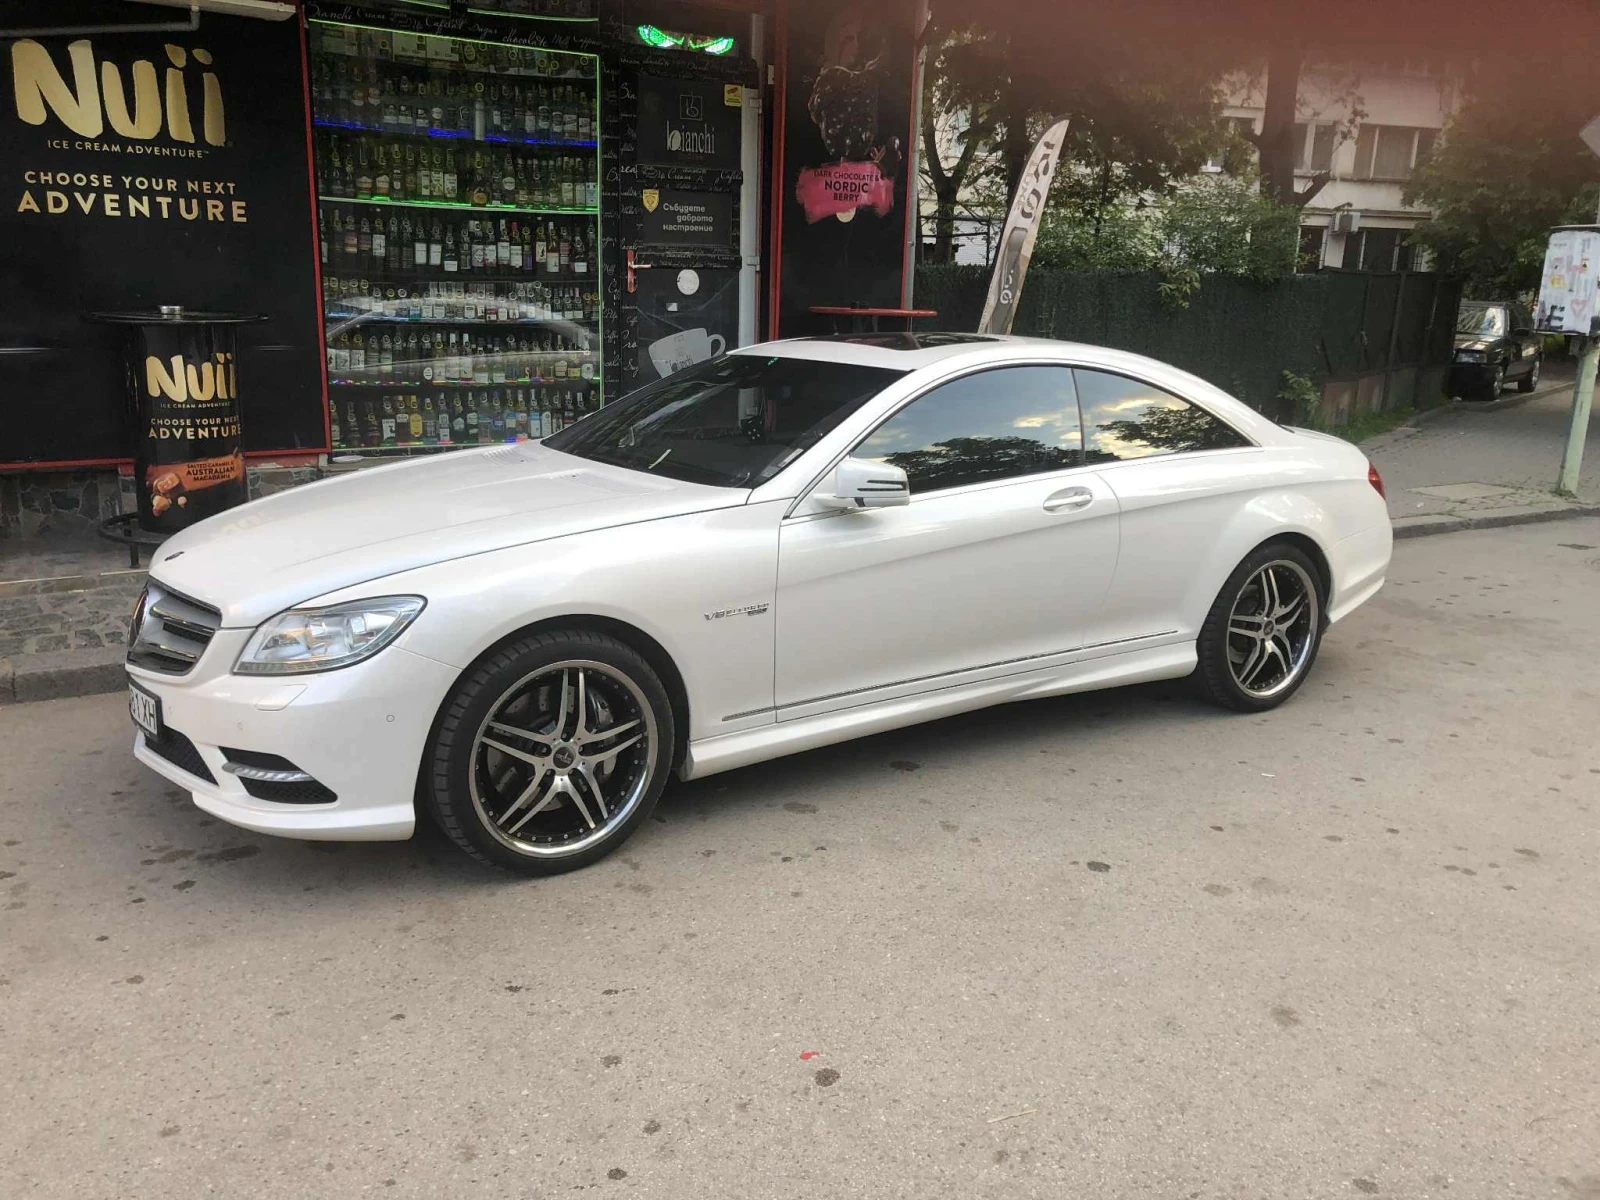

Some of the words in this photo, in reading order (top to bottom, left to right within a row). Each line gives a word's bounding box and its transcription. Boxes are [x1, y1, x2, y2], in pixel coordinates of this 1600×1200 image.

[11, 38, 226, 147] Nuii
[47, 139, 70, 149] ICE
[75, 141, 121, 153] CREAM
[814, 170, 832, 178] DARK
[833, 171, 873, 181] CHOCOLATE
[24, 171, 113, 188] CHOOSE
[121, 176, 177, 191] YOUR
[187, 180, 236, 195] NEXT
[824, 180, 869, 194] NORDIC
[833, 193, 859, 203] BERRY
[18, 190, 248, 223] ADVENTURE
[663, 202, 706, 214] Събудете
[676, 213, 713, 223] доброто
[662, 224, 713, 232] настроение
[145, 352, 237, 402] Nuii
[151, 417, 191, 426] CHOOSE
[195, 416, 221, 426] YOUR
[148, 424, 242, 440] ADVENTURE
[186, 466, 235, 476] AUSTRALIAN
[193, 474, 231, 482] MACADAMIA
